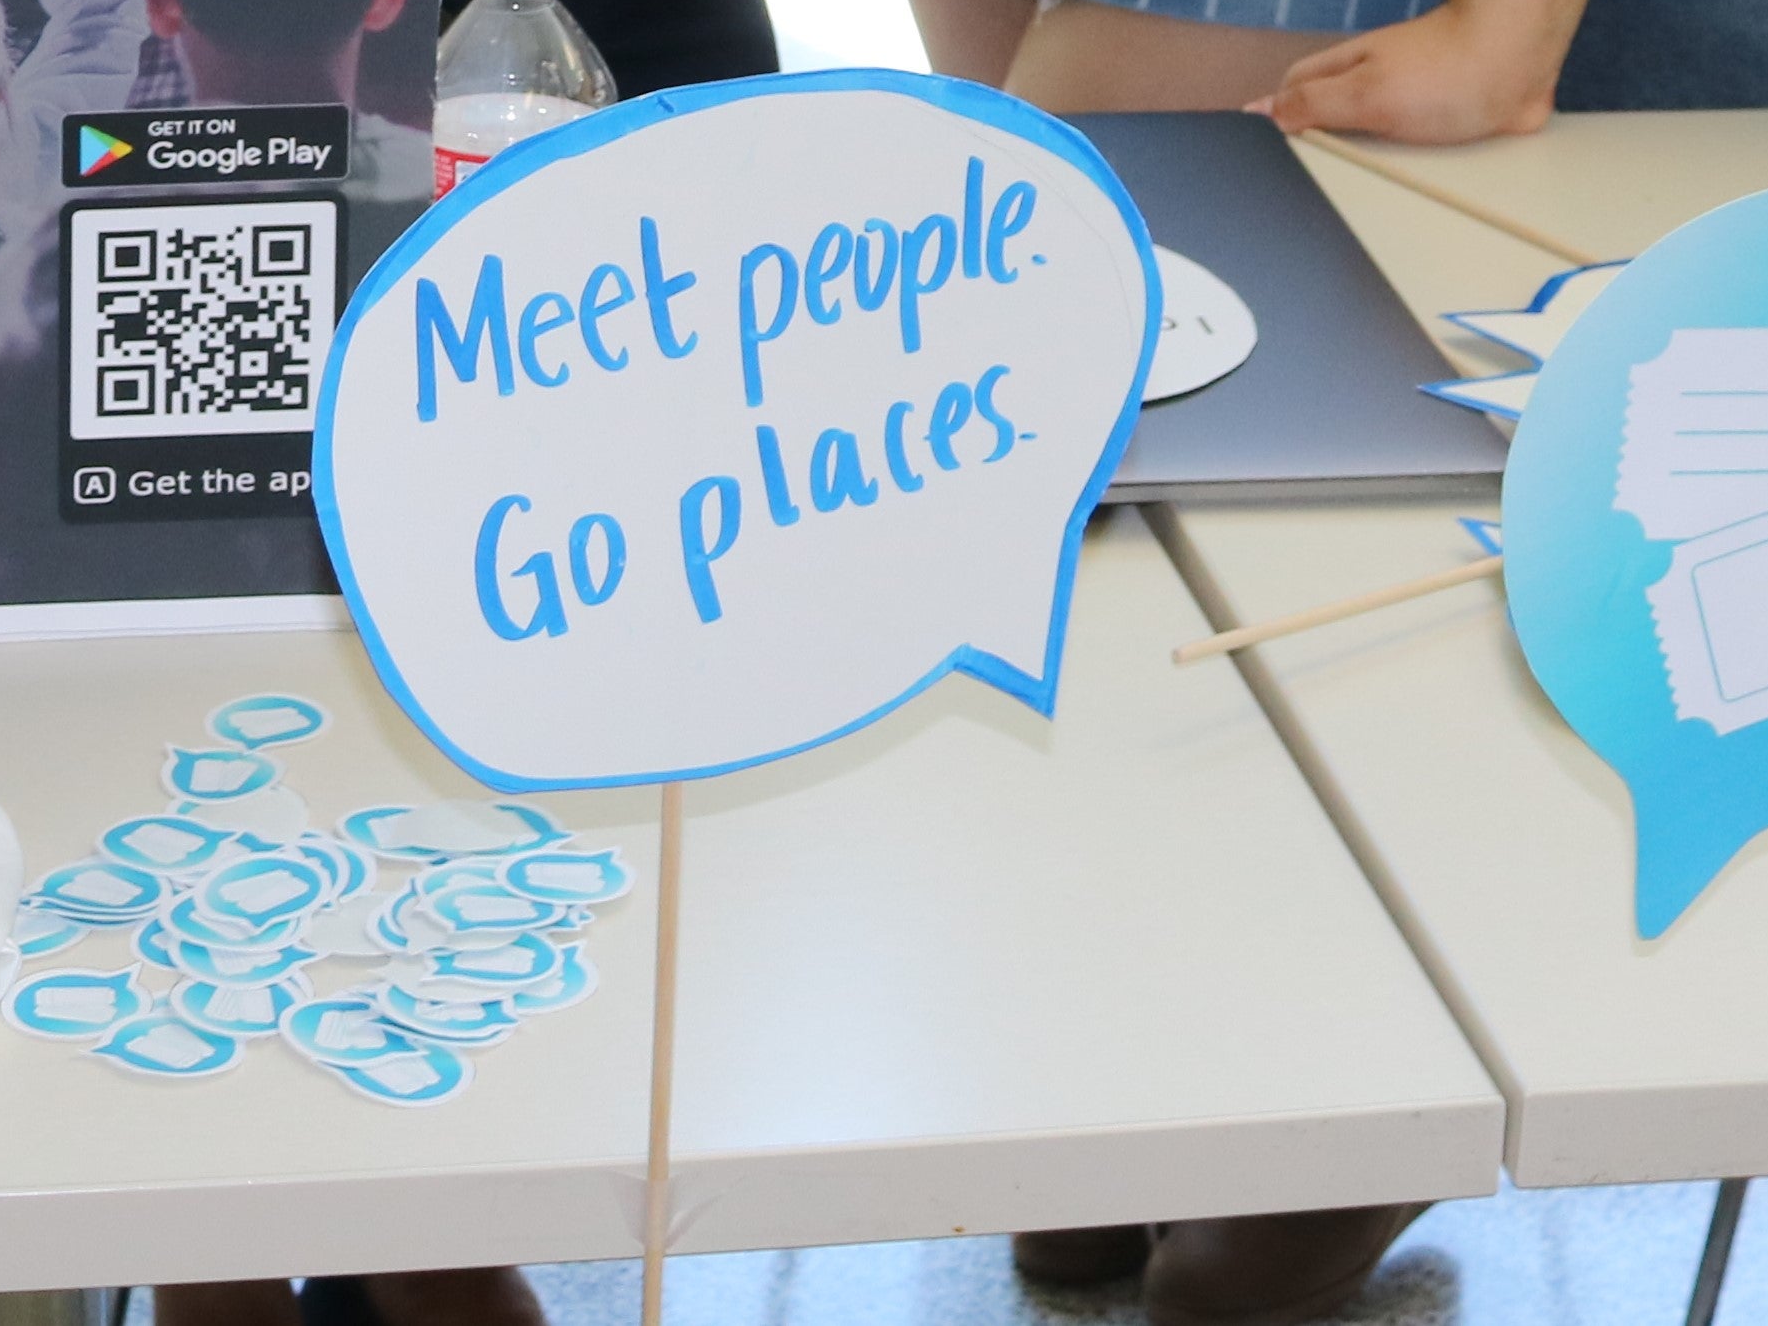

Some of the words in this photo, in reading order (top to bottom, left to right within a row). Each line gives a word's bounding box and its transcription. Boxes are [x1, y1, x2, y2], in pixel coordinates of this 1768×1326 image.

[147, 120, 184, 137] GET
[187, 119, 203, 135] IT
[206, 118, 237, 135] ON
[146, 138, 263, 175] Google
[266, 136, 332, 172] Play
[414, 215, 699, 423] Meet
[737, 156, 1049, 408] people.
[128, 469, 192, 497] Get
[202, 467, 256, 494] the
[268, 468, 312, 499] ap
[473, 492, 627, 642] Go
[678, 363, 1039, 625] places.
